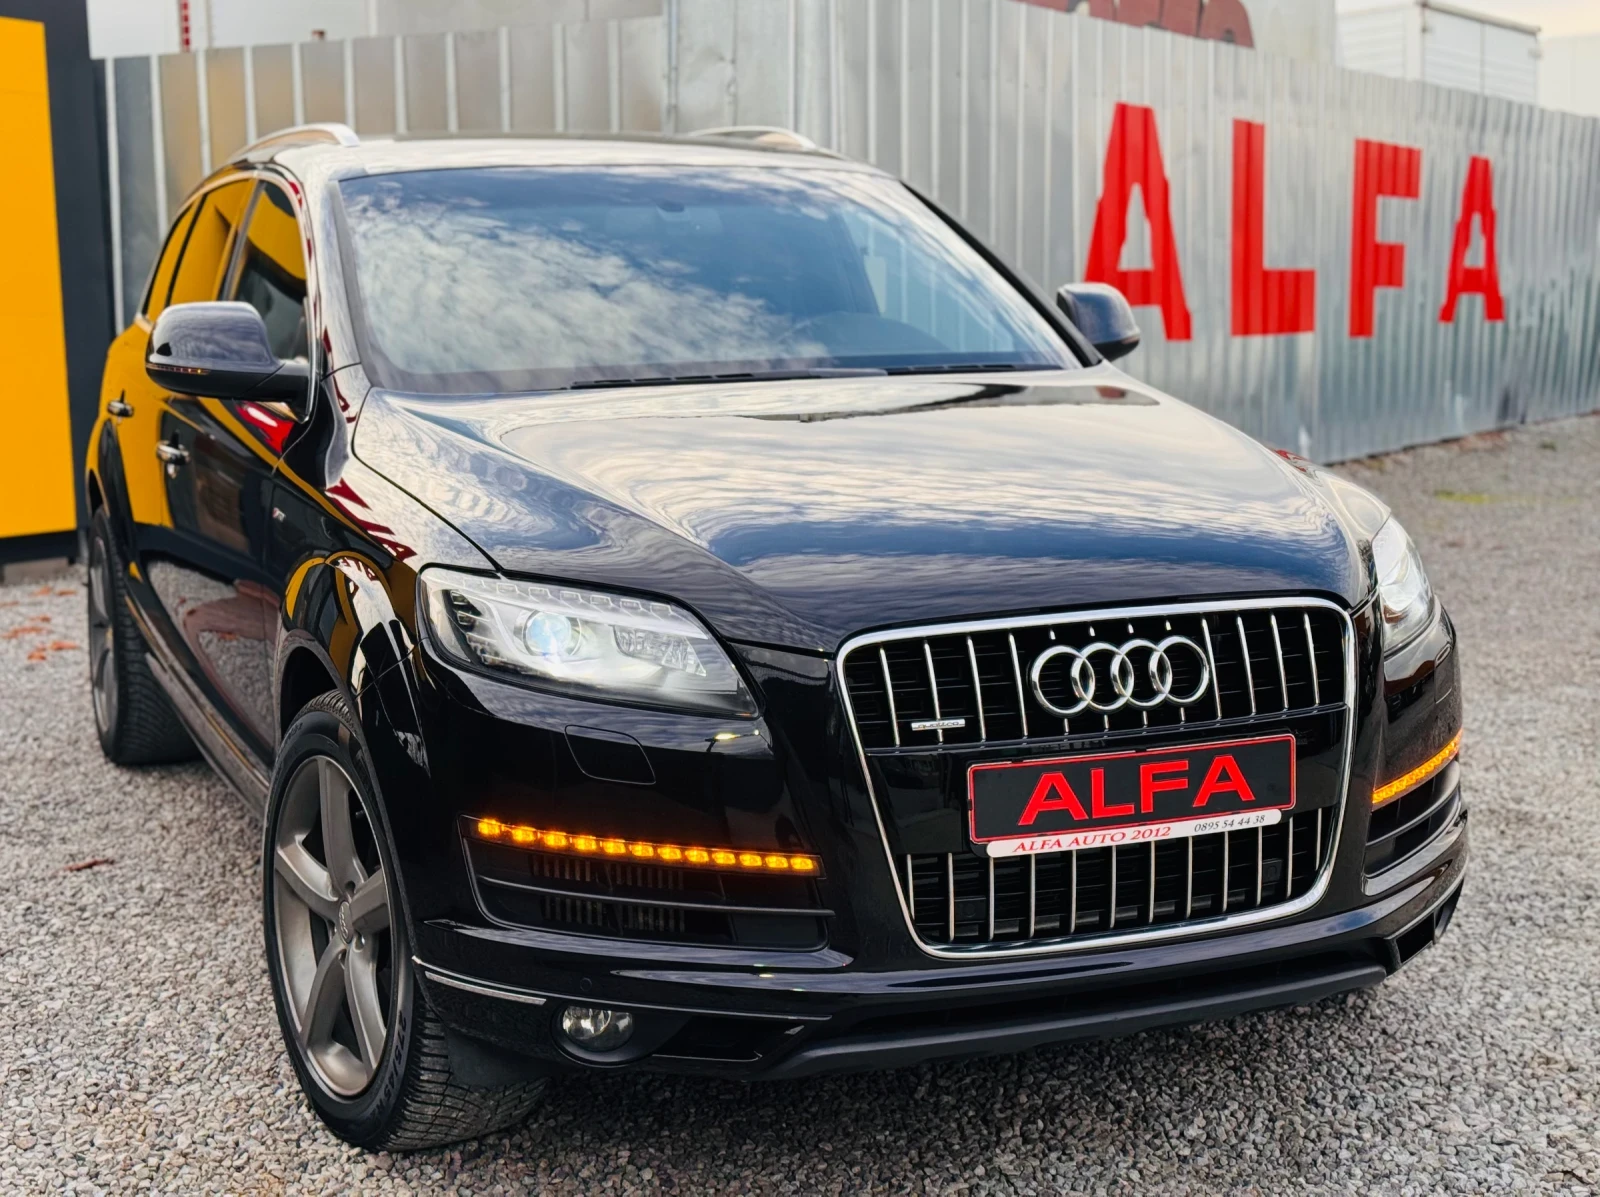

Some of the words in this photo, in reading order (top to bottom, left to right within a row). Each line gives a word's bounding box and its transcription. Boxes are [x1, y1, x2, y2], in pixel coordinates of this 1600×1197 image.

[1084, 101, 1505, 342] ALFA
[1017, 754, 1256, 826] ALFA
[1012, 837, 1063, 853] ALFA
[1066, 831, 1126, 848] AUTO
[1130, 826, 1172, 841] 2012
[1193, 820, 1220, 833] 0895
[1222, 818, 1235, 829] 54
[1237, 816, 1251, 827] 44
[1253, 814, 1266, 825] 38
